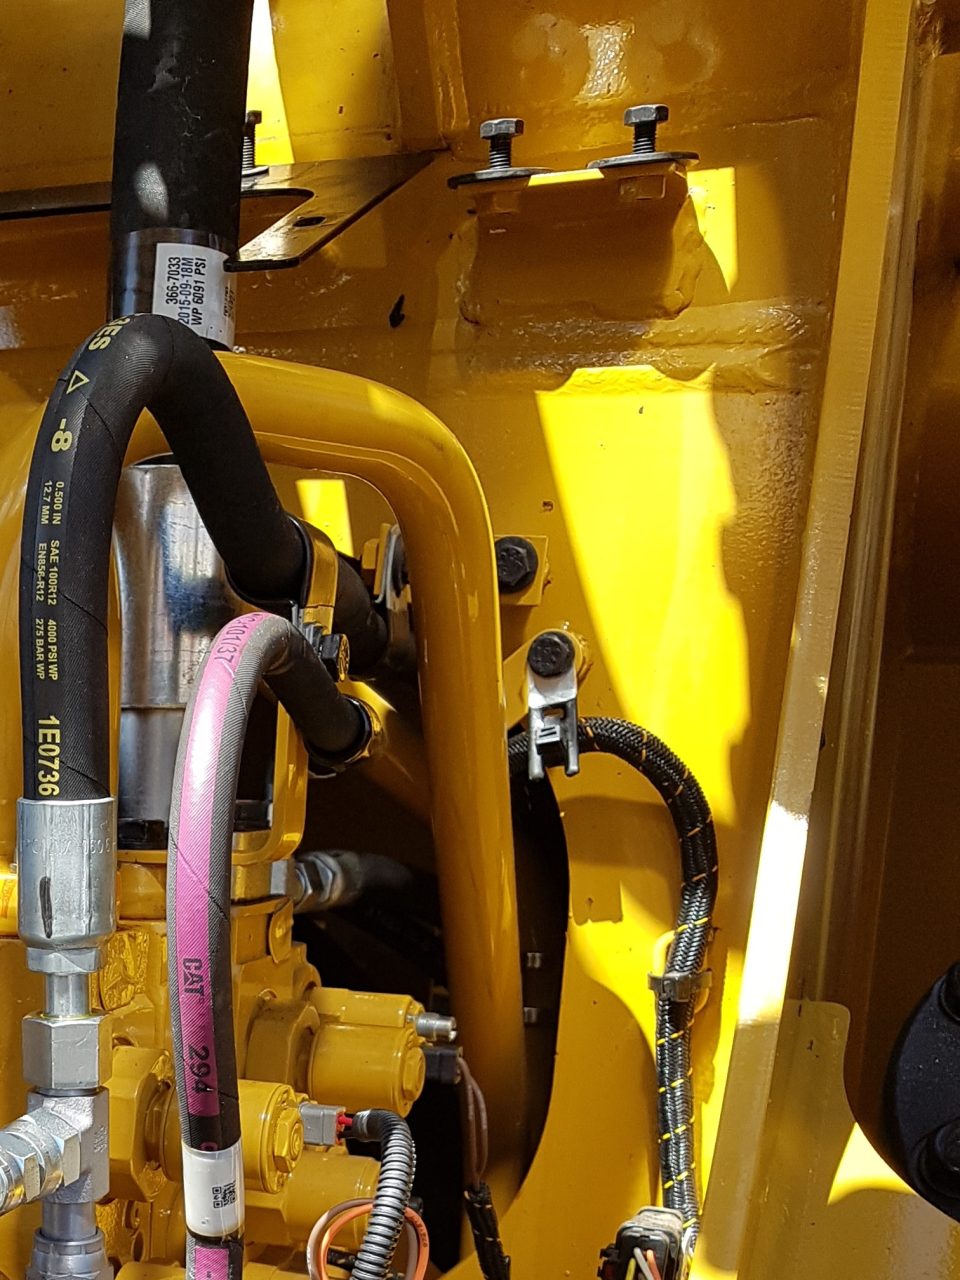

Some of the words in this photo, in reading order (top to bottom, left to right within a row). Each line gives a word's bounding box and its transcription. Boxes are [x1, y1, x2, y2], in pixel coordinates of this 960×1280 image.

[194, 256, 208, 276] PSI
[165, 256, 181, 305] 366-7033
[177, 256, 194, 326] 2015-09-18M
[192, 279, 206, 305] 6091
[190, 307, 203, 326] WP
[50, 418, 74, 453] -8
[42, 480, 53, 504] 12.7
[52, 481, 65, 510] 0.500
[40, 507, 50, 525] MM
[51, 512, 62, 525] IN
[49, 539, 60, 563] SAE
[46, 565, 59, 606] 100R12
[35, 617, 46, 636] 275
[46, 619, 58, 643] 4000
[35, 638, 46, 660] BAR
[46, 644, 58, 662] PSI
[36, 662, 46, 680] WP
[46, 664, 58, 681] WP
[36, 714, 61, 796] 1E0736
[182, 957, 206, 997] CAT
[189, 1044, 215, 1095] 294
